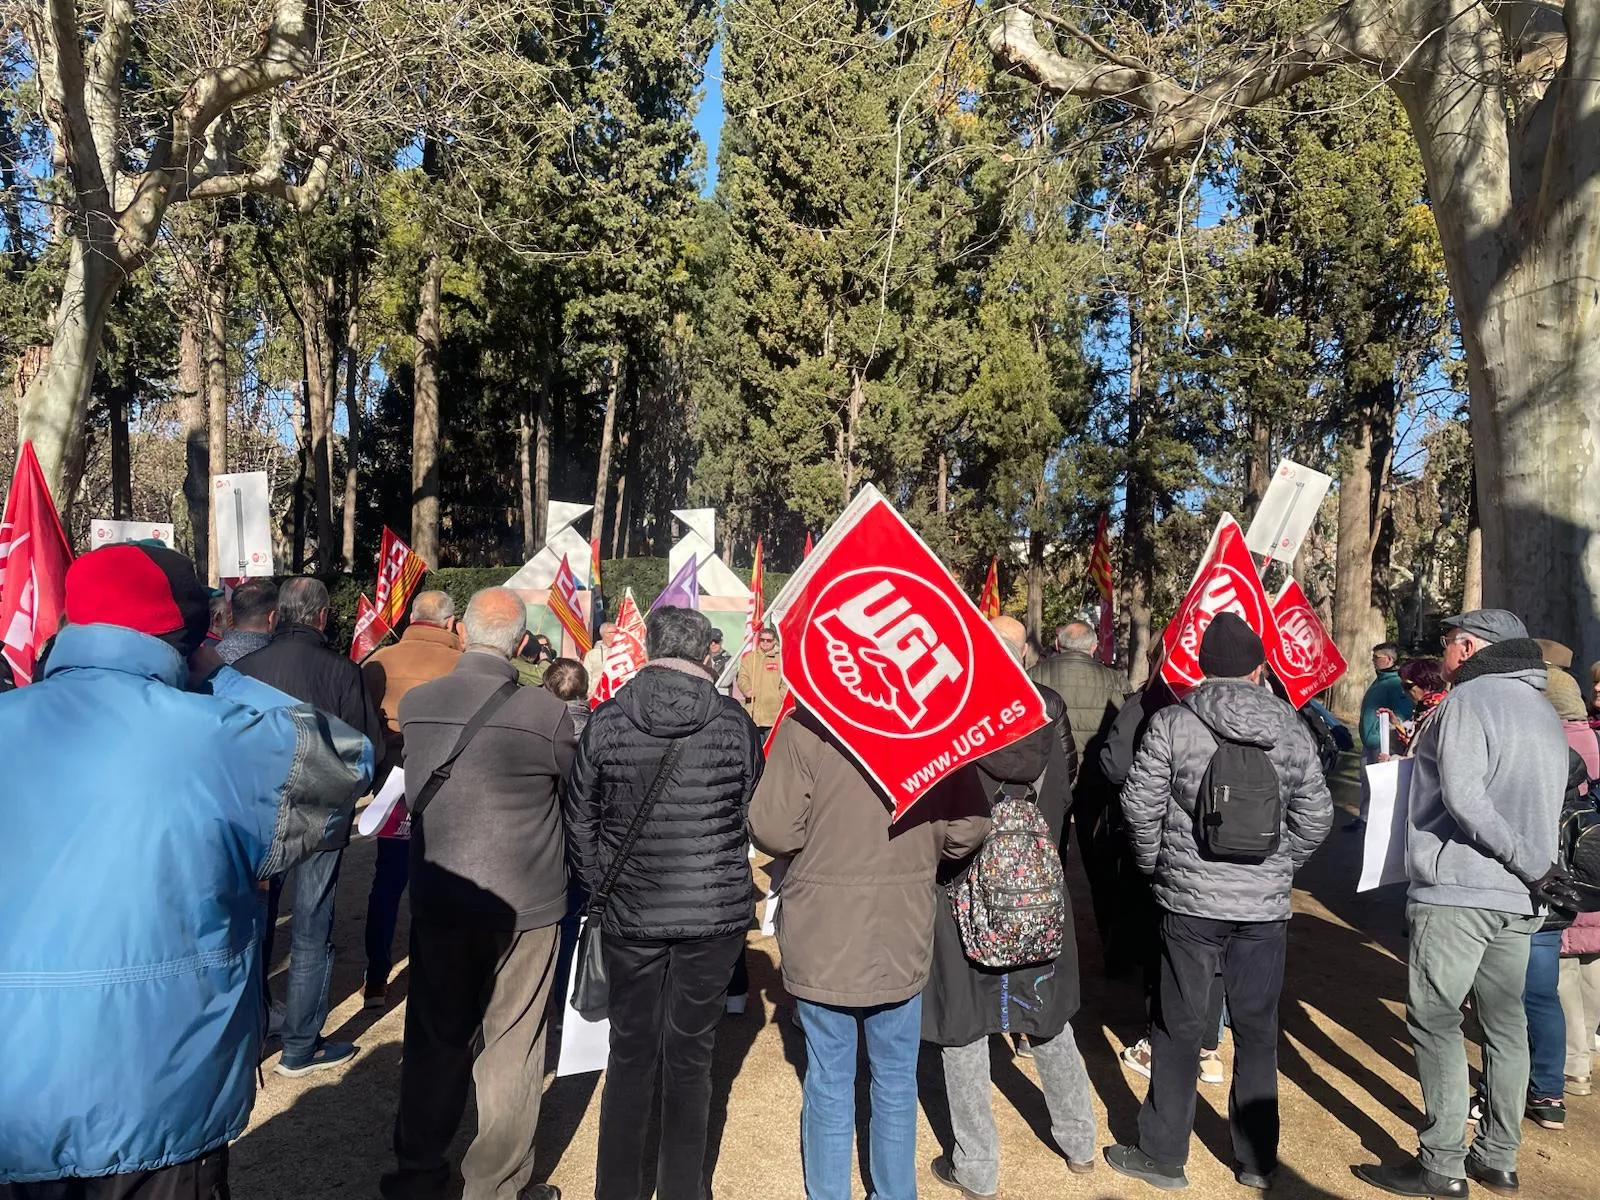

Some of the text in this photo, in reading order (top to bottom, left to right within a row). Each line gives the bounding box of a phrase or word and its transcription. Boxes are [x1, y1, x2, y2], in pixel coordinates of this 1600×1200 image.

[838, 579, 964, 702] UGT
[1283, 611, 1321, 661] UGT
[901, 699, 1027, 794] www.UGT.es
